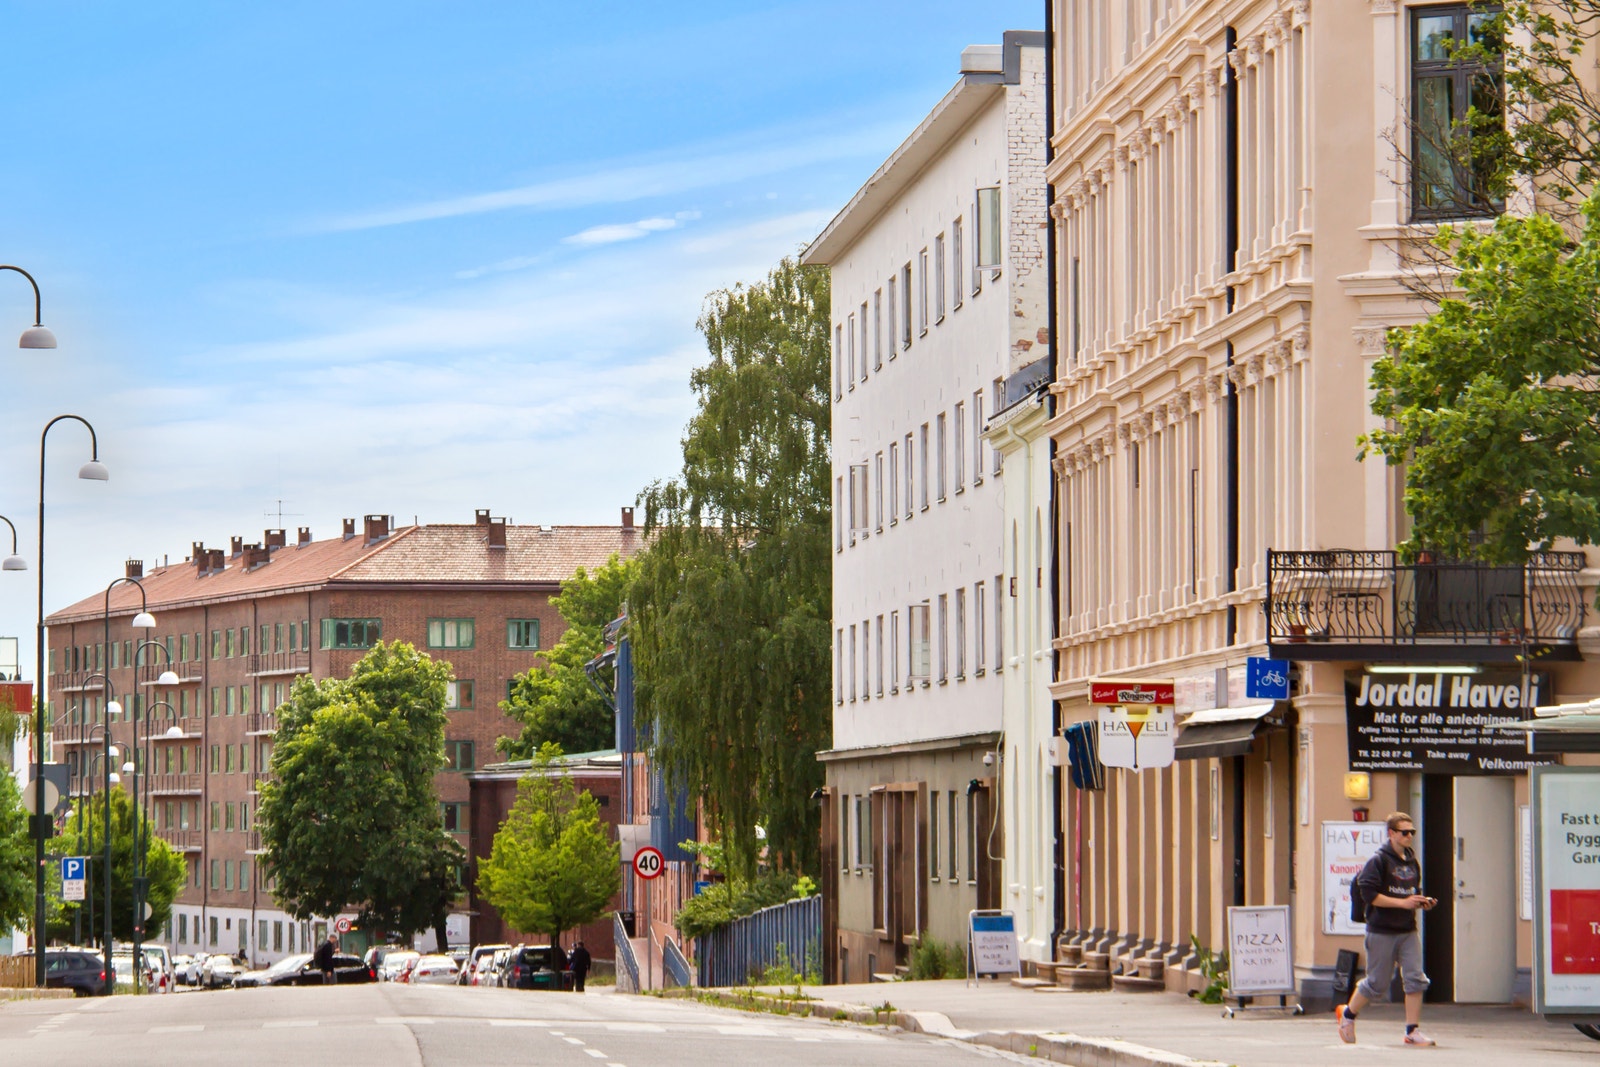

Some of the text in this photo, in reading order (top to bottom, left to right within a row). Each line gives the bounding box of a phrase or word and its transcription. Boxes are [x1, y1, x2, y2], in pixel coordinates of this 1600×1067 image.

[1118, 691, 1154, 701] Ringnes
[1356, 673, 1540, 708] Jordal Haveli
[1374, 712, 1397, 724] Mat
[1400, 712, 1417, 724] for
[1420, 712, 1443, 725] alle
[1103, 721, 1168, 732] HAVELI
[1370, 735, 1400, 744] Levering
[1371, 750, 1380, 758] 22
[1426, 750, 1446, 759] Take
[1447, 752, 1470, 761] away
[1561, 812, 1590, 825] Fast
[1326, 829, 1383, 844] HAVELI
[638, 855, 659, 871] 40
[1572, 851, 1600, 864] Gar
[68, 860, 80, 878] P
[339, 921, 349, 929] 40
[1236, 932, 1283, 946] PIZZA
